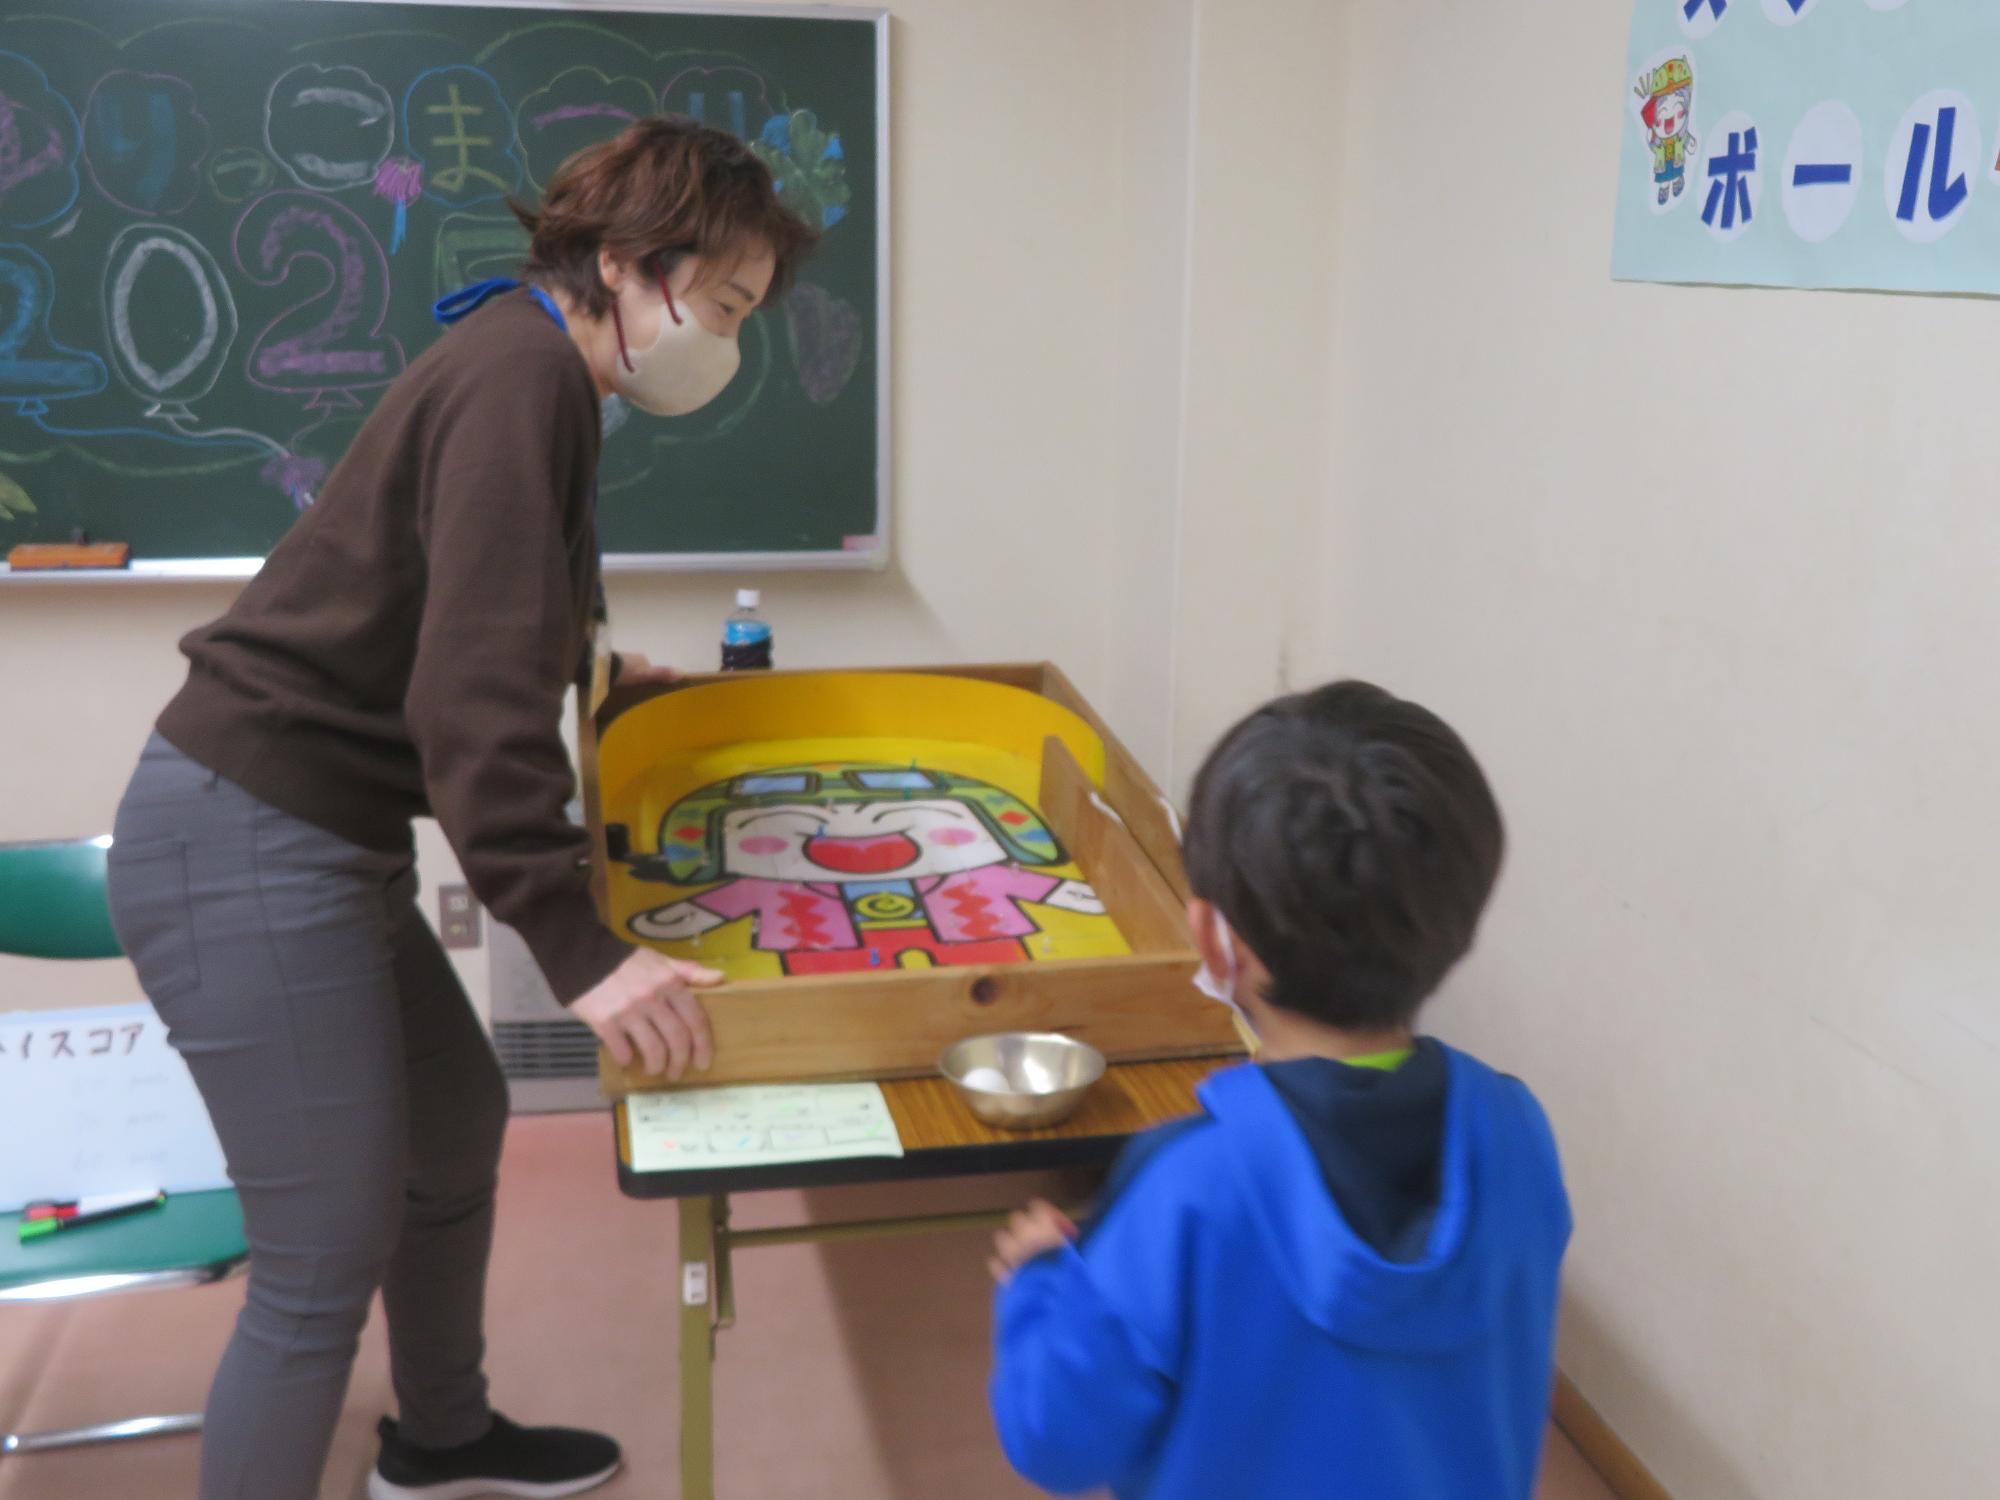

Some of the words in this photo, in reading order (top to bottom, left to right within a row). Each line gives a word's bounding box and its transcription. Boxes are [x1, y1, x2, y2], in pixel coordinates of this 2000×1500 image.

[1701, 107, 1967, 230] ボール
[0, 1023, 144, 1060] イスコア
